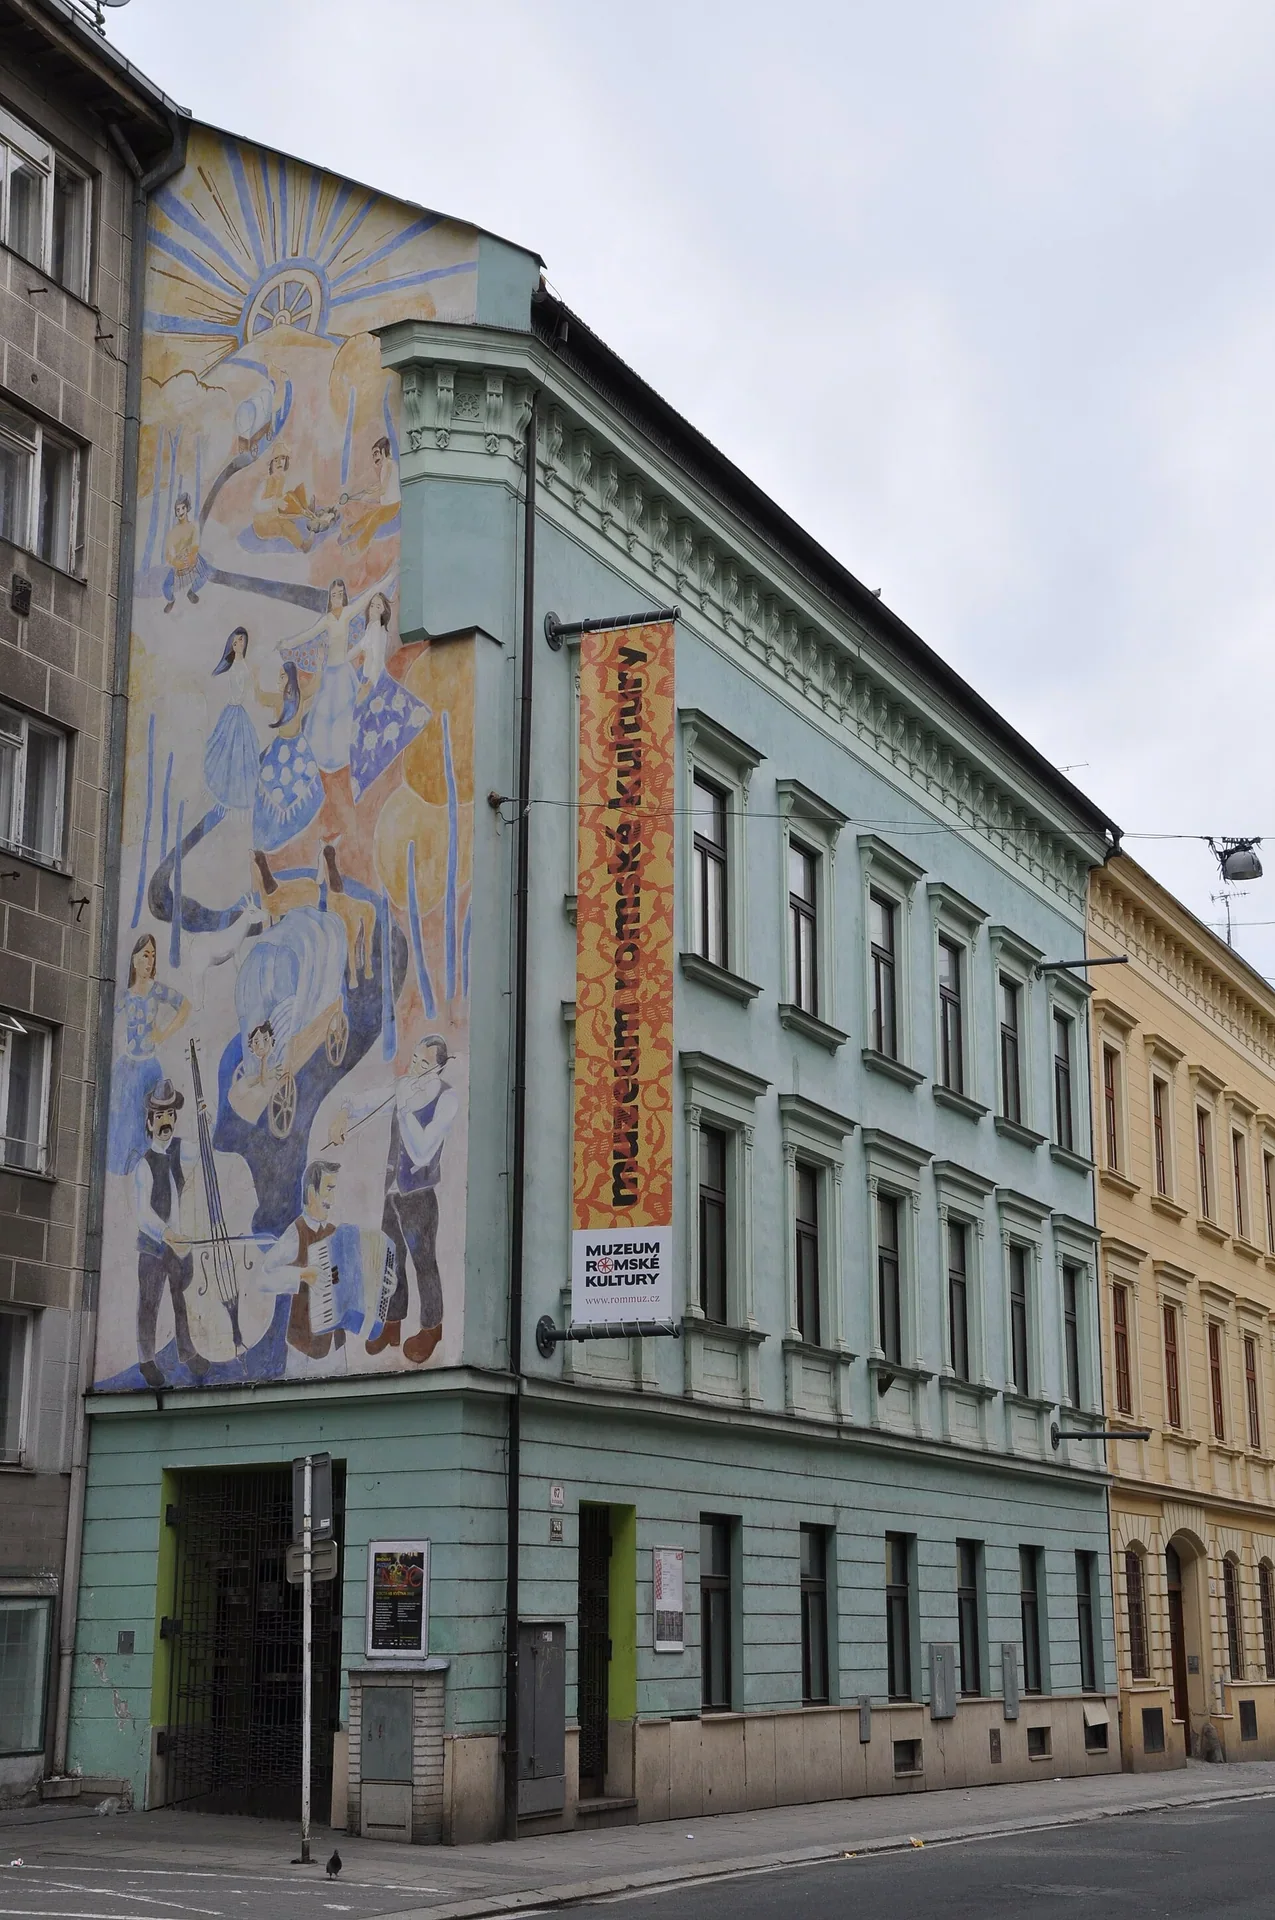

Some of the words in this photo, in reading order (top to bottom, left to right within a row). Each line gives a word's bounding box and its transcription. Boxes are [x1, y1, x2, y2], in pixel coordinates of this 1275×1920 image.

[608, 646, 648, 809] kultury
[605, 820, 641, 991] romské
[612, 1002, 640, 1207] muzeum
[586, 1241, 660, 1257] MUZEUM
[586, 1253, 660, 1274] ROMSKÉ
[585, 1273, 660, 1288] KULTURY
[585, 1294, 661, 1305] www.rommuz.cz
